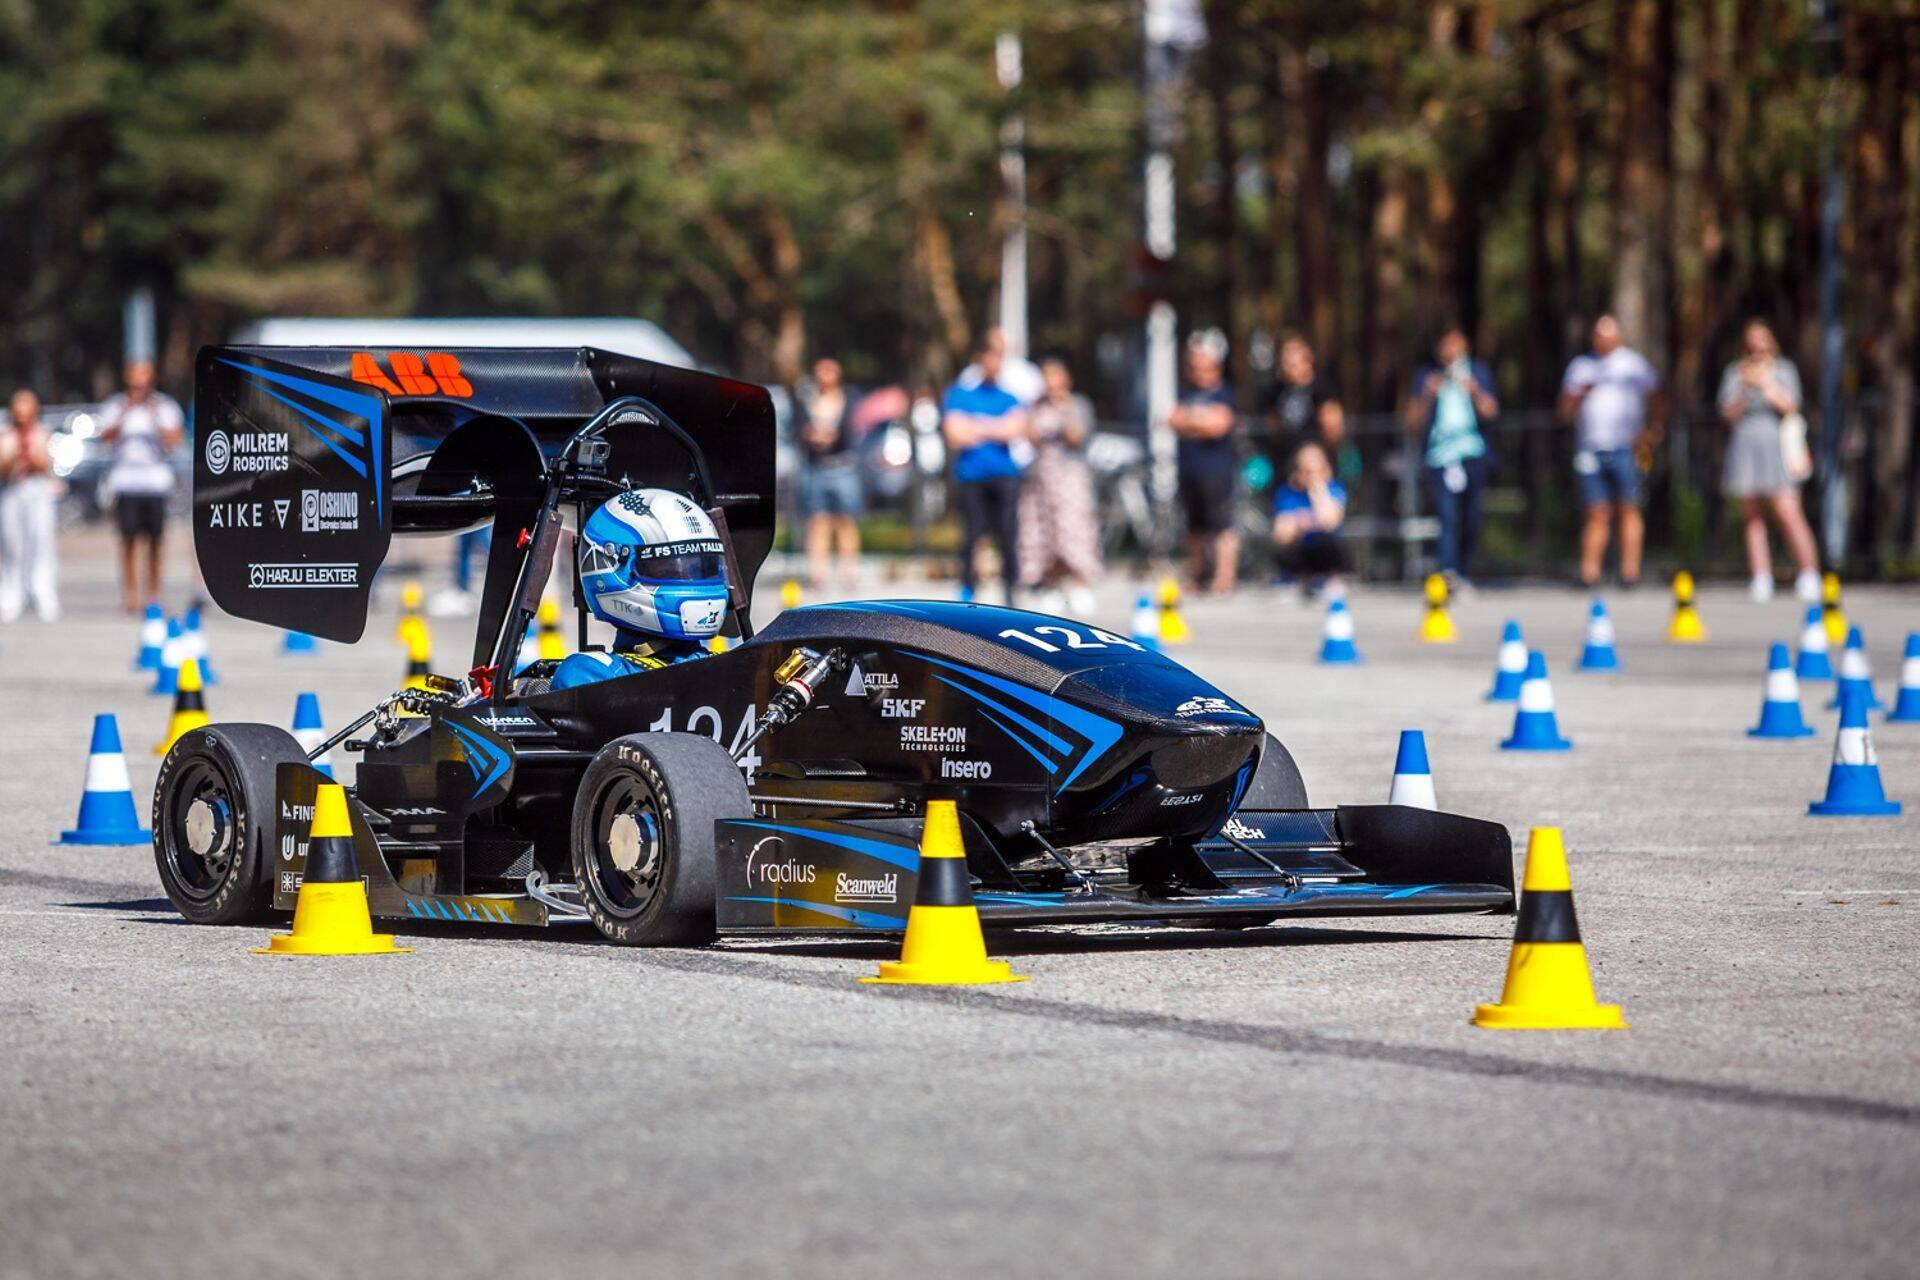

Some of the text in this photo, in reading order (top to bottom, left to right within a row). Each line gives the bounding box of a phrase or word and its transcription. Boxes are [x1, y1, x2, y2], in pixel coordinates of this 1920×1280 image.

[352, 353, 473, 397] ABB
[233, 433, 289, 452] MILREM
[233, 456, 289, 471] ROBOTICS
[210, 503, 262, 527] ÄIKE
[320, 492, 358, 518] OSHINO
[655, 546, 671, 557] FS
[672, 543, 700, 555] TEAM
[266, 568, 357, 582] HARJU ELEKTER
[999, 626, 1147, 652] 124
[864, 673, 899, 684] ATTILA
[881, 699, 926, 718] SKF
[901, 743, 966, 752] TECHNOLOGIES
[941, 757, 992, 779] insero
[760, 858, 816, 883] radius
[835, 872, 897, 898] Scanweld
